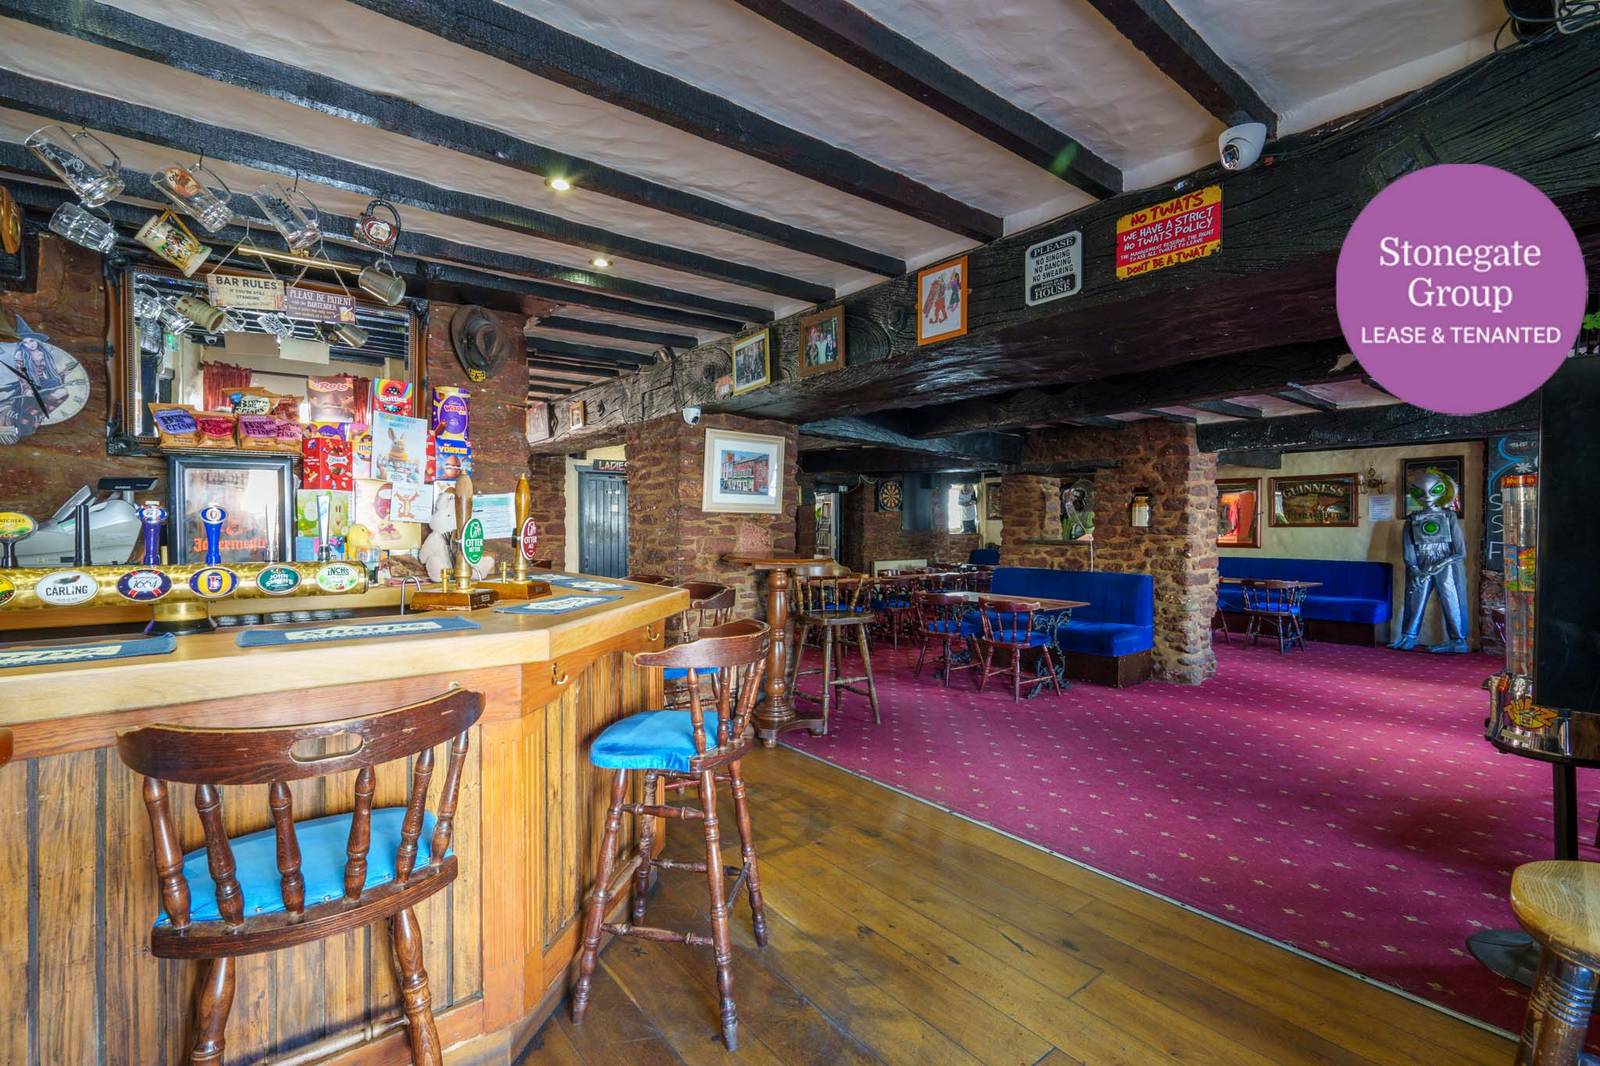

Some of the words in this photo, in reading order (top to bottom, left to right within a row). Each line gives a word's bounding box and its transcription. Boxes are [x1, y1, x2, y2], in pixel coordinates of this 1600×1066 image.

[1150, 191, 1204, 220] TWATS
[1123, 232, 1138, 242] WE
[1139, 222, 1163, 238] HAVE
[1166, 219, 1173, 230] A
[1175, 206, 1214, 227] STRICT
[1137, 229, 1172, 248] TWATS
[1174, 217, 1213, 237] POLICY
[1033, 237, 1074, 258] PLEASE
[1130, 243, 1161, 257] MANAGEMENT
[1035, 257, 1044, 266] NO
[1045, 248, 1071, 263] SINGING
[1152, 257, 1165, 268] BE
[1166, 254, 1175, 265] A
[1176, 244, 1208, 261] TWAT
[1032, 274, 1041, 283] NO
[1042, 263, 1074, 280] SWEARING
[1034, 265, 1043, 274] NO
[1045, 256, 1072, 271] DANCING
[216, 275, 240, 287] BAR
[241, 278, 277, 290] RULES
[289, 289, 313, 300] PLEASE
[315, 292, 325, 301] BE
[326, 294, 351, 306] PATIENT
[1035, 284, 1072, 300] HOUSE
[379, 394, 408, 404] Skittles
[439, 445, 467, 454] YORKIE
[1282, 483, 1345, 498] GUINNESS
[465, 538, 484, 548] OTTER
[523, 536, 538, 545] OTTER
[45, 585, 88, 597] CARLING
